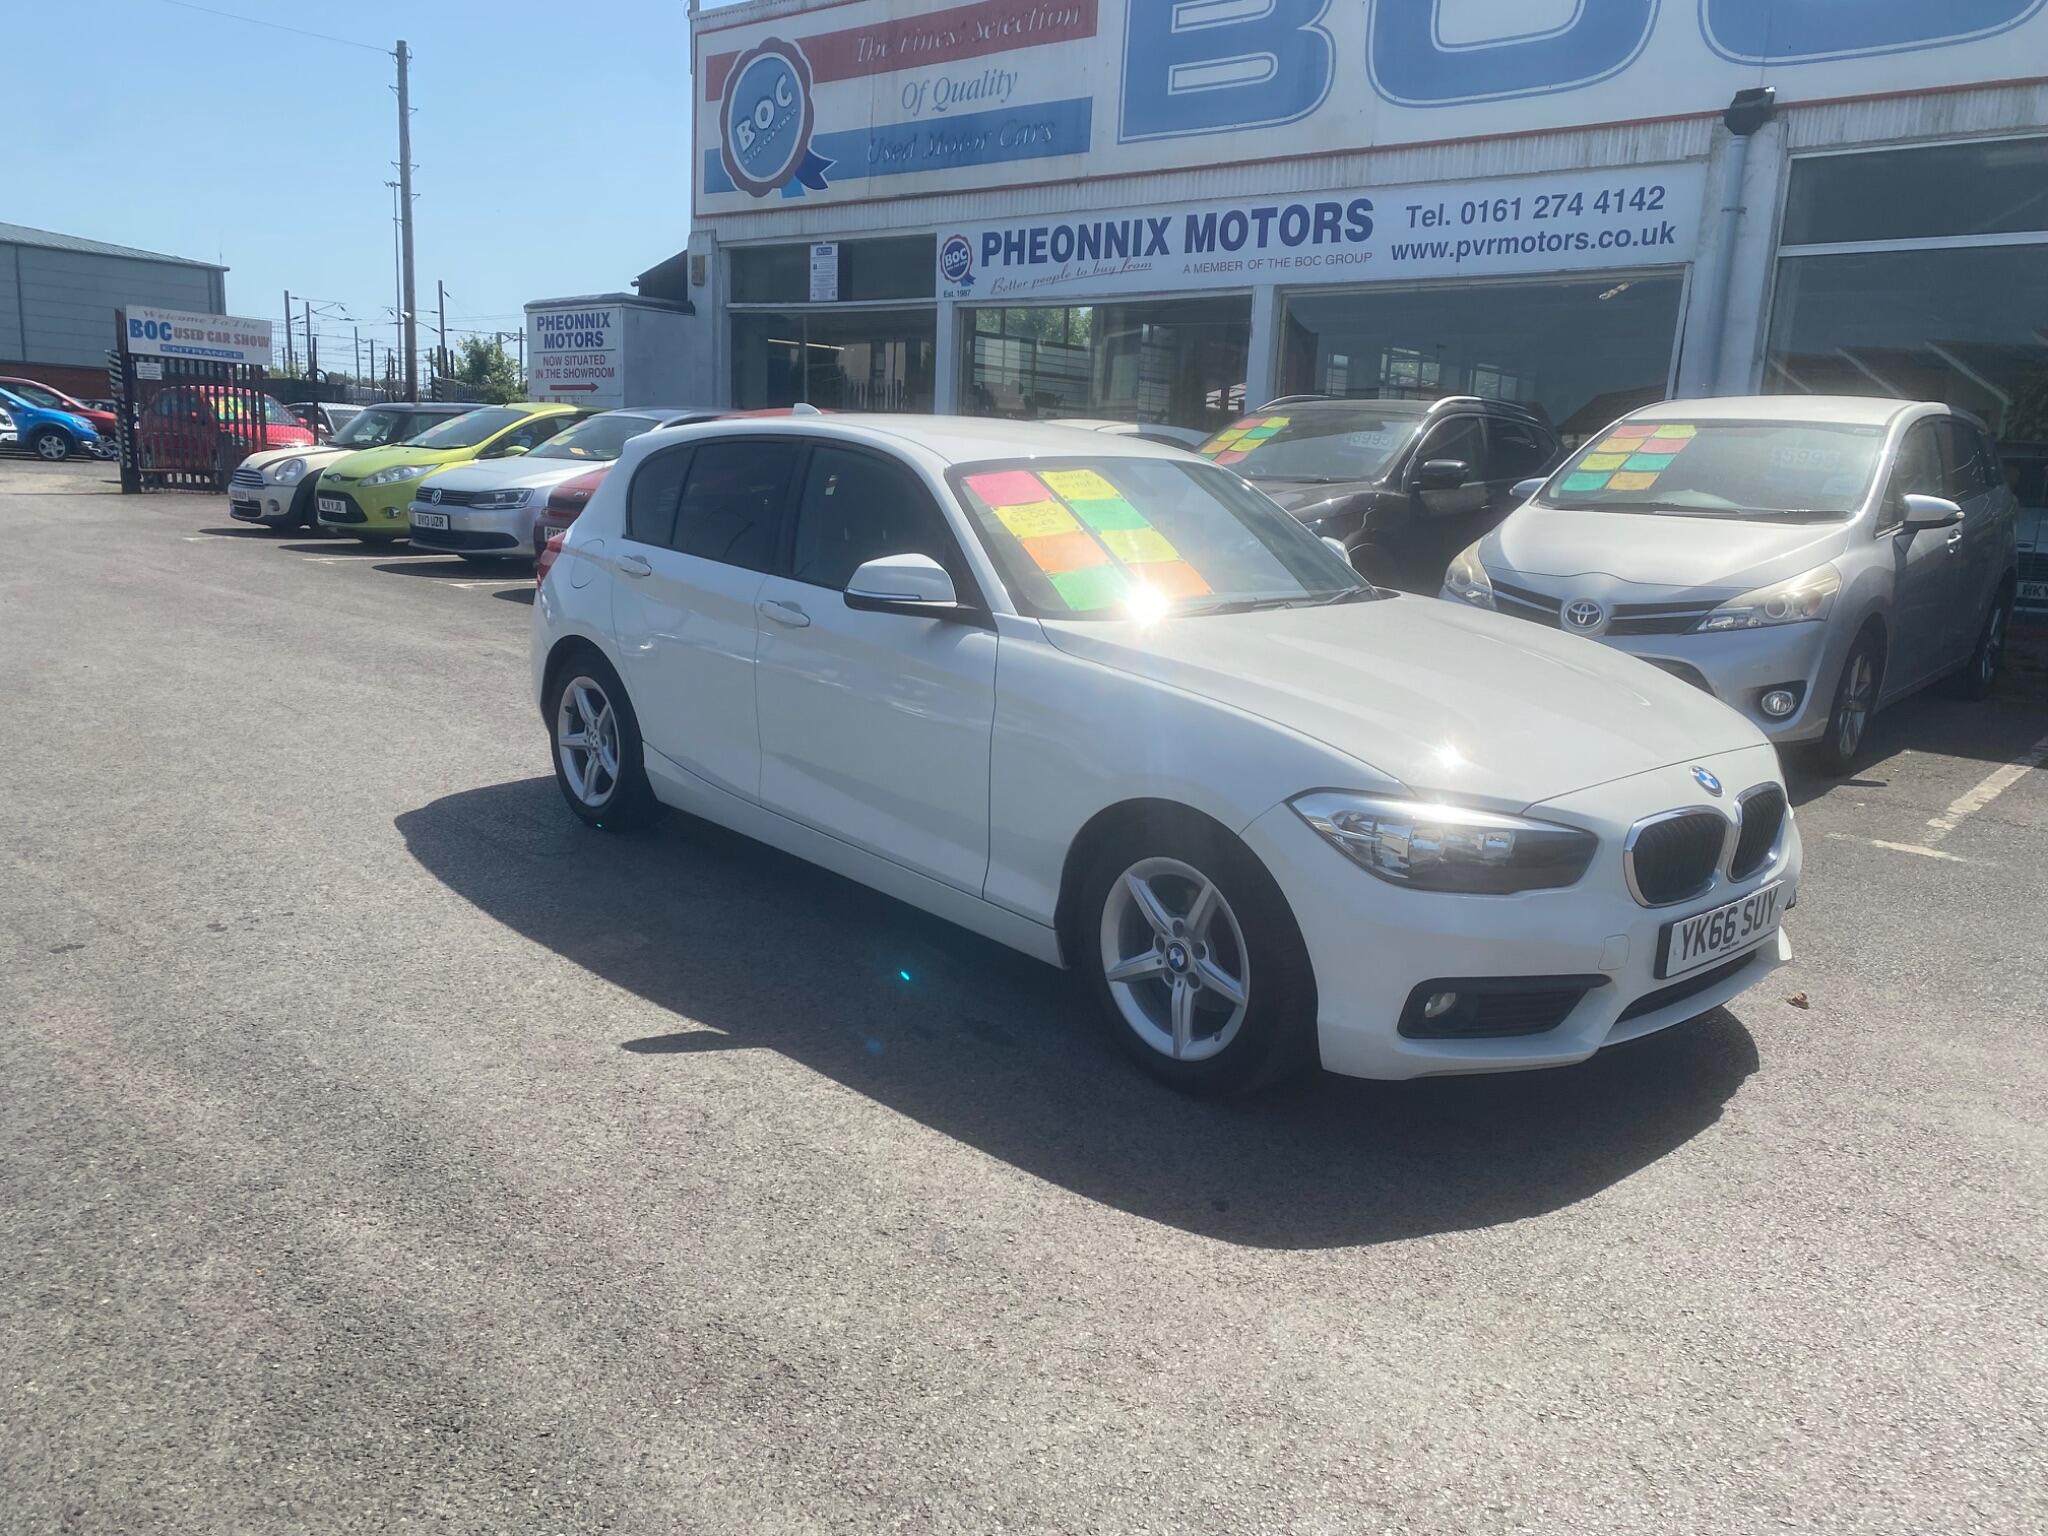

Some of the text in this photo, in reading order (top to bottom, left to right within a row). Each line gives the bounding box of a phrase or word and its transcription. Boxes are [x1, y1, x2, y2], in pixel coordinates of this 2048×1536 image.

[902, 68, 1018, 117] Of Quality
[736, 72, 793, 153] BOC
[1000, 119, 1055, 149] Cars
[1406, 185, 1666, 229] Tel. 0161 274 4142
[981, 198, 1374, 268] PHEONNIX MOTORS
[1391, 221, 1677, 262] www.pvrmotors.co.uk
[945, 247, 968, 267] BOC
[1183, 252, 1373, 274] A MEMBER OF THE BOC GROUP
[990, 256, 1153, 296] Better people to buy from
[129, 318, 270, 348] BOC USED CAR SHOW
[536, 312, 611, 332] PHEONNIX
[543, 331, 604, 349] MOTORS
[535, 367, 615, 379] IN THE SHOWROOM
[543, 354, 606, 367] NOW SITUATED
[1682, 887, 1778, 961] YK66 SUY
